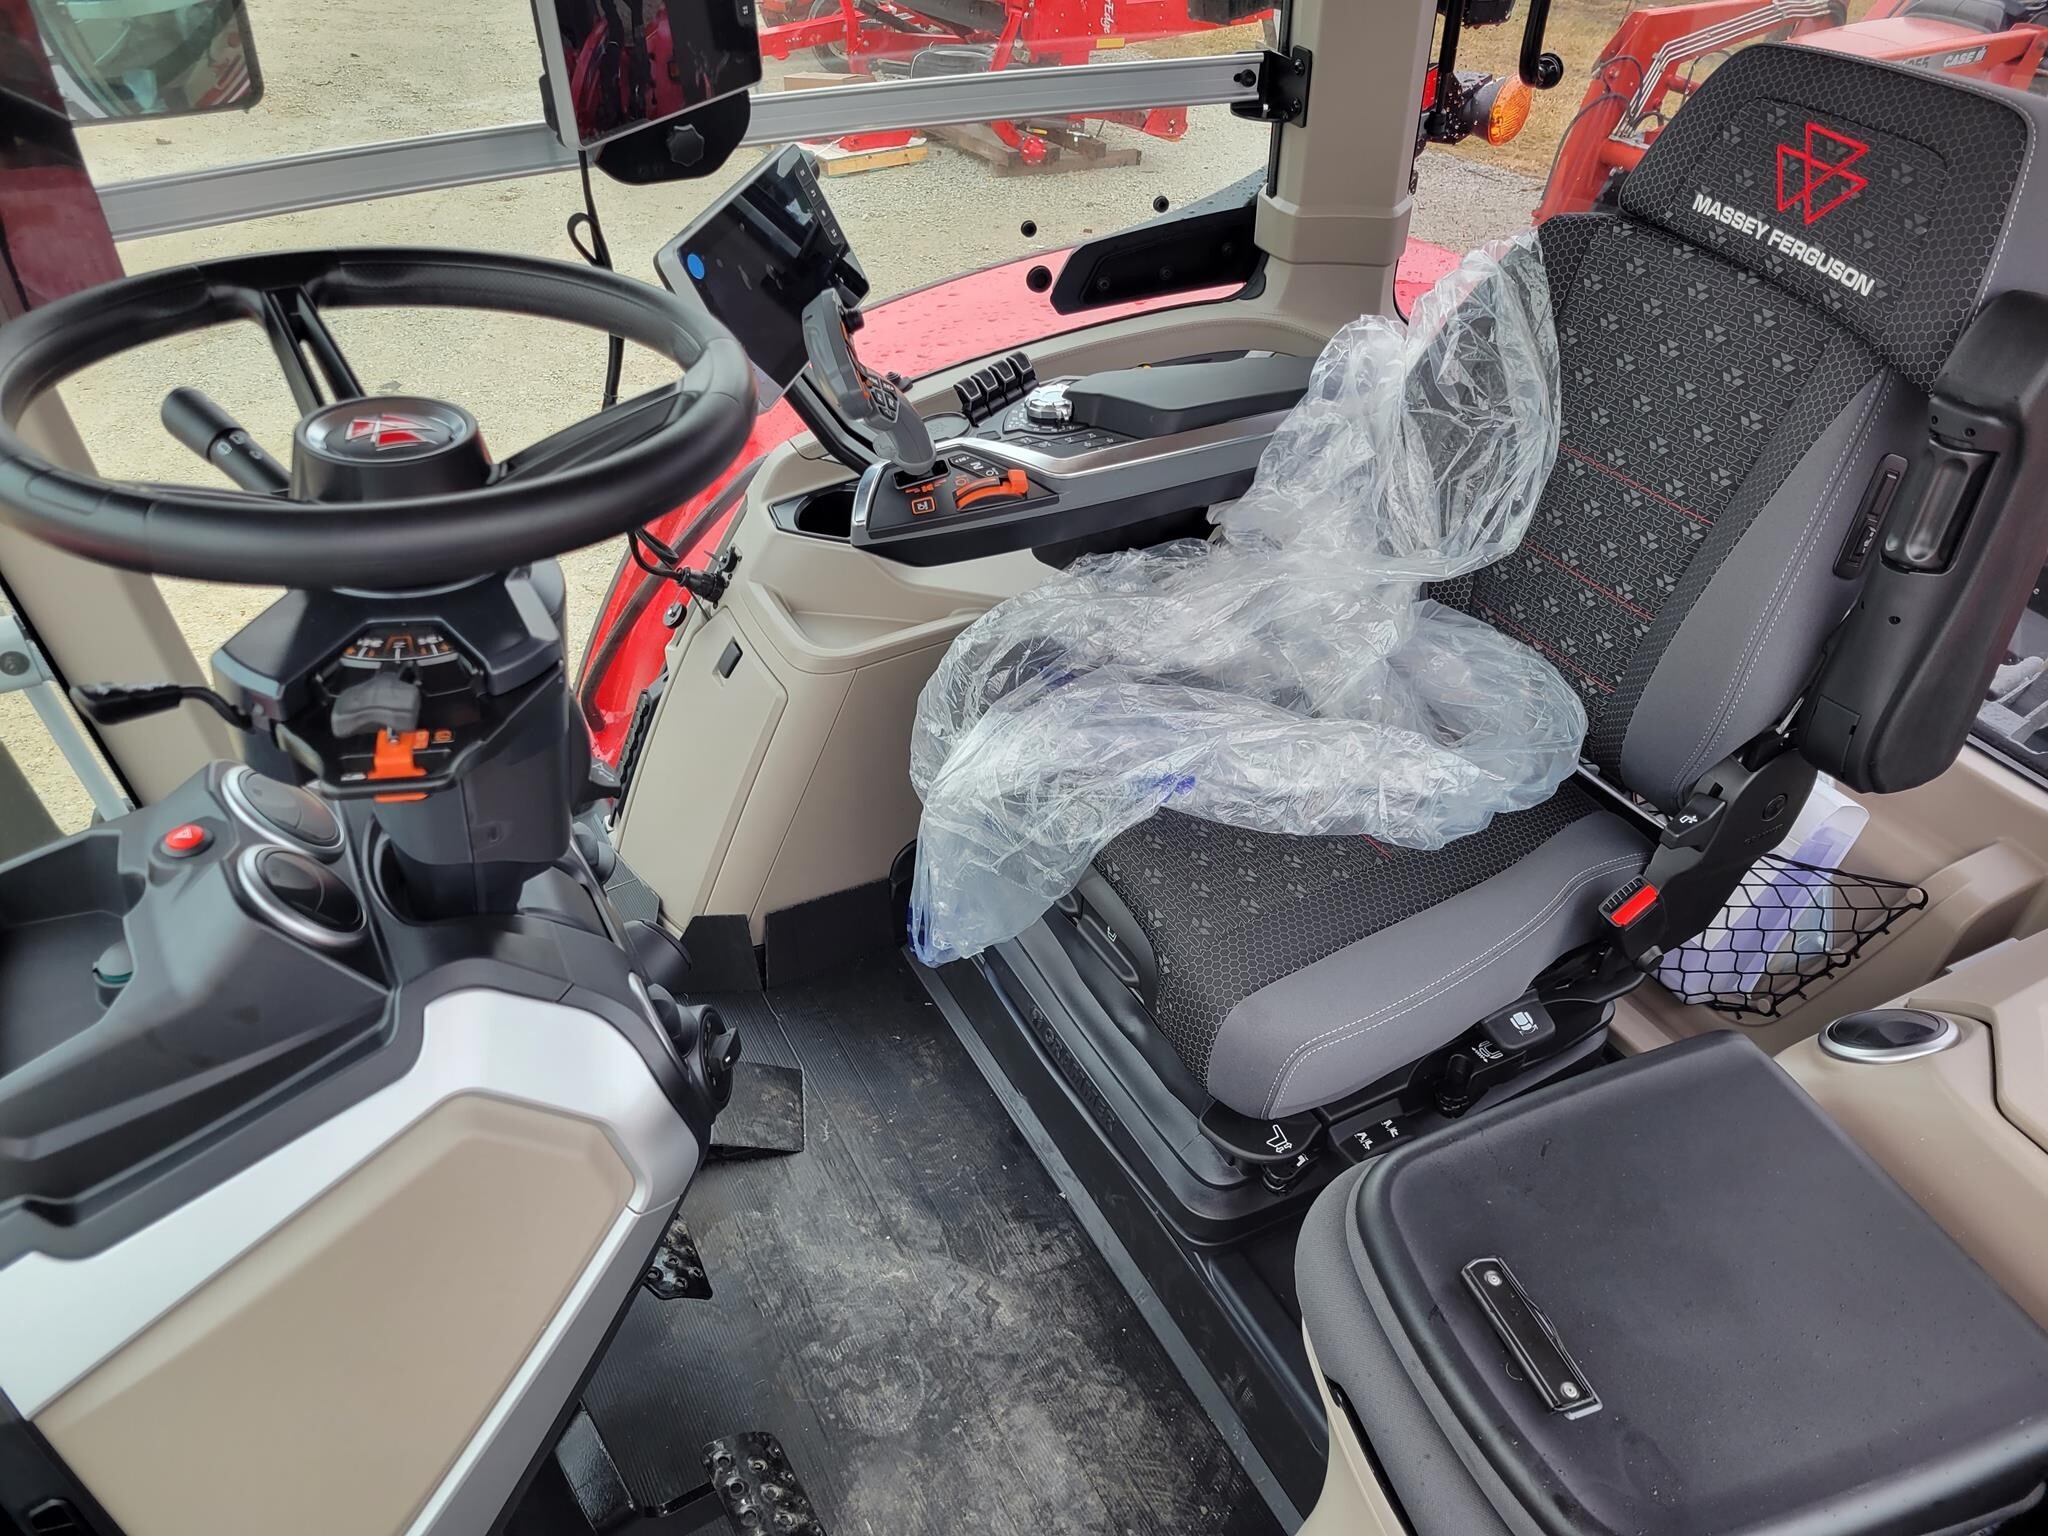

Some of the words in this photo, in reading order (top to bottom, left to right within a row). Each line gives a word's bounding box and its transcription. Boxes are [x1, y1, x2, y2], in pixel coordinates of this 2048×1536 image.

[1943, 51, 1977, 68] CASE
[1692, 193, 1770, 240] MASSEY
[1767, 228, 1875, 297] FERGUSON
